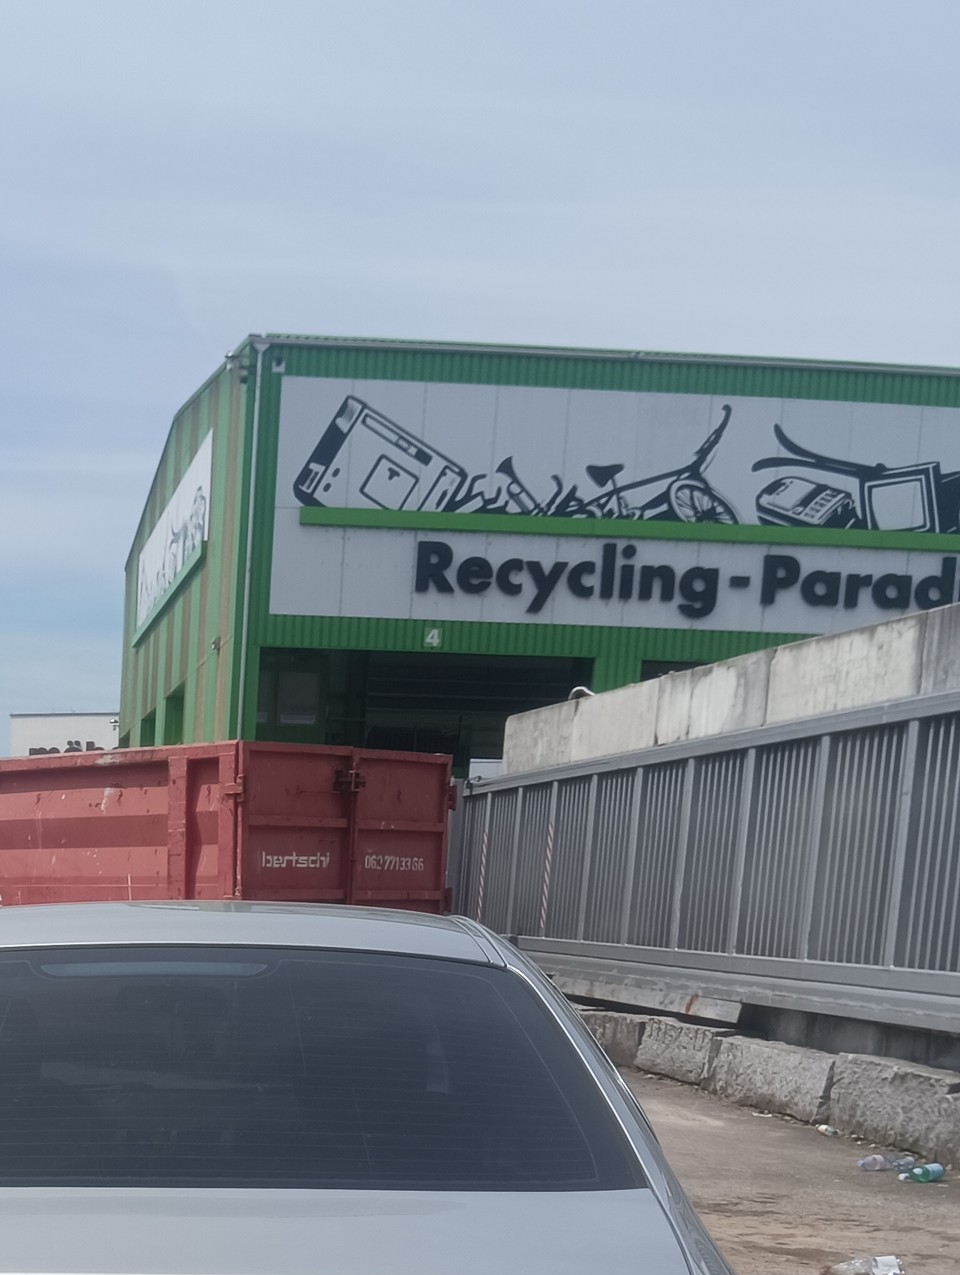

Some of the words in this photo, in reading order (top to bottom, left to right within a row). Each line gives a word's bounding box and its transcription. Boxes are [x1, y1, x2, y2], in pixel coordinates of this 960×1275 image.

[415, 540, 960, 617] Recycling-Parad
[425, 629, 439, 647] 4
[262, 851, 330, 868] bertschi
